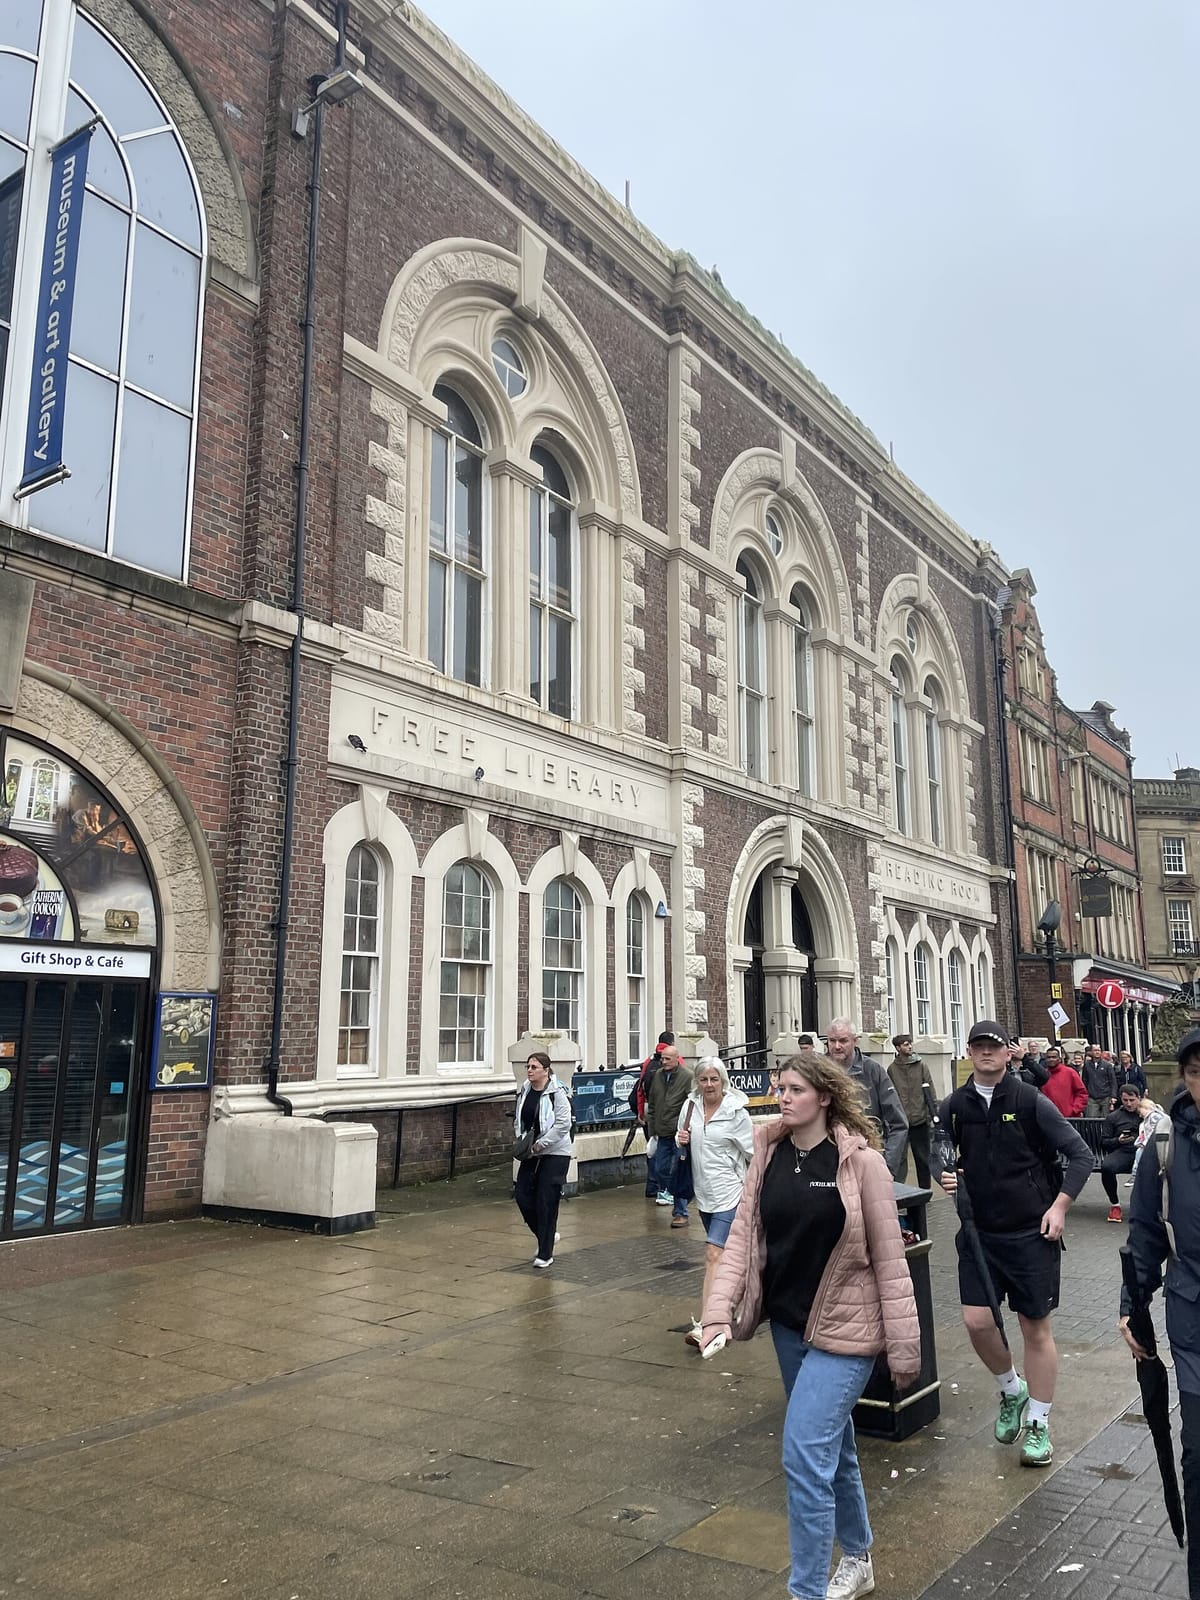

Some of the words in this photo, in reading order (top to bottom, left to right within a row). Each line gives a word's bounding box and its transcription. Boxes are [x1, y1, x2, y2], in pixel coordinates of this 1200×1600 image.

[51, 154, 76, 276] museum
[50, 280, 66, 305] &
[45, 310, 61, 352] art
[33, 358, 57, 462] gallery
[372, 706, 477, 761] FREE
[505, 746, 642, 808] LIBRARY
[31, 902, 64, 917] COOKSON
[20, 951, 47, 965] Gift
[48, 952, 82, 969] Shop
[85, 955, 94, 967] &
[97, 955, 124, 969] Café
[1105, 985, 1117, 1006] L
[729, 1074, 762, 1090] SCRAN!
